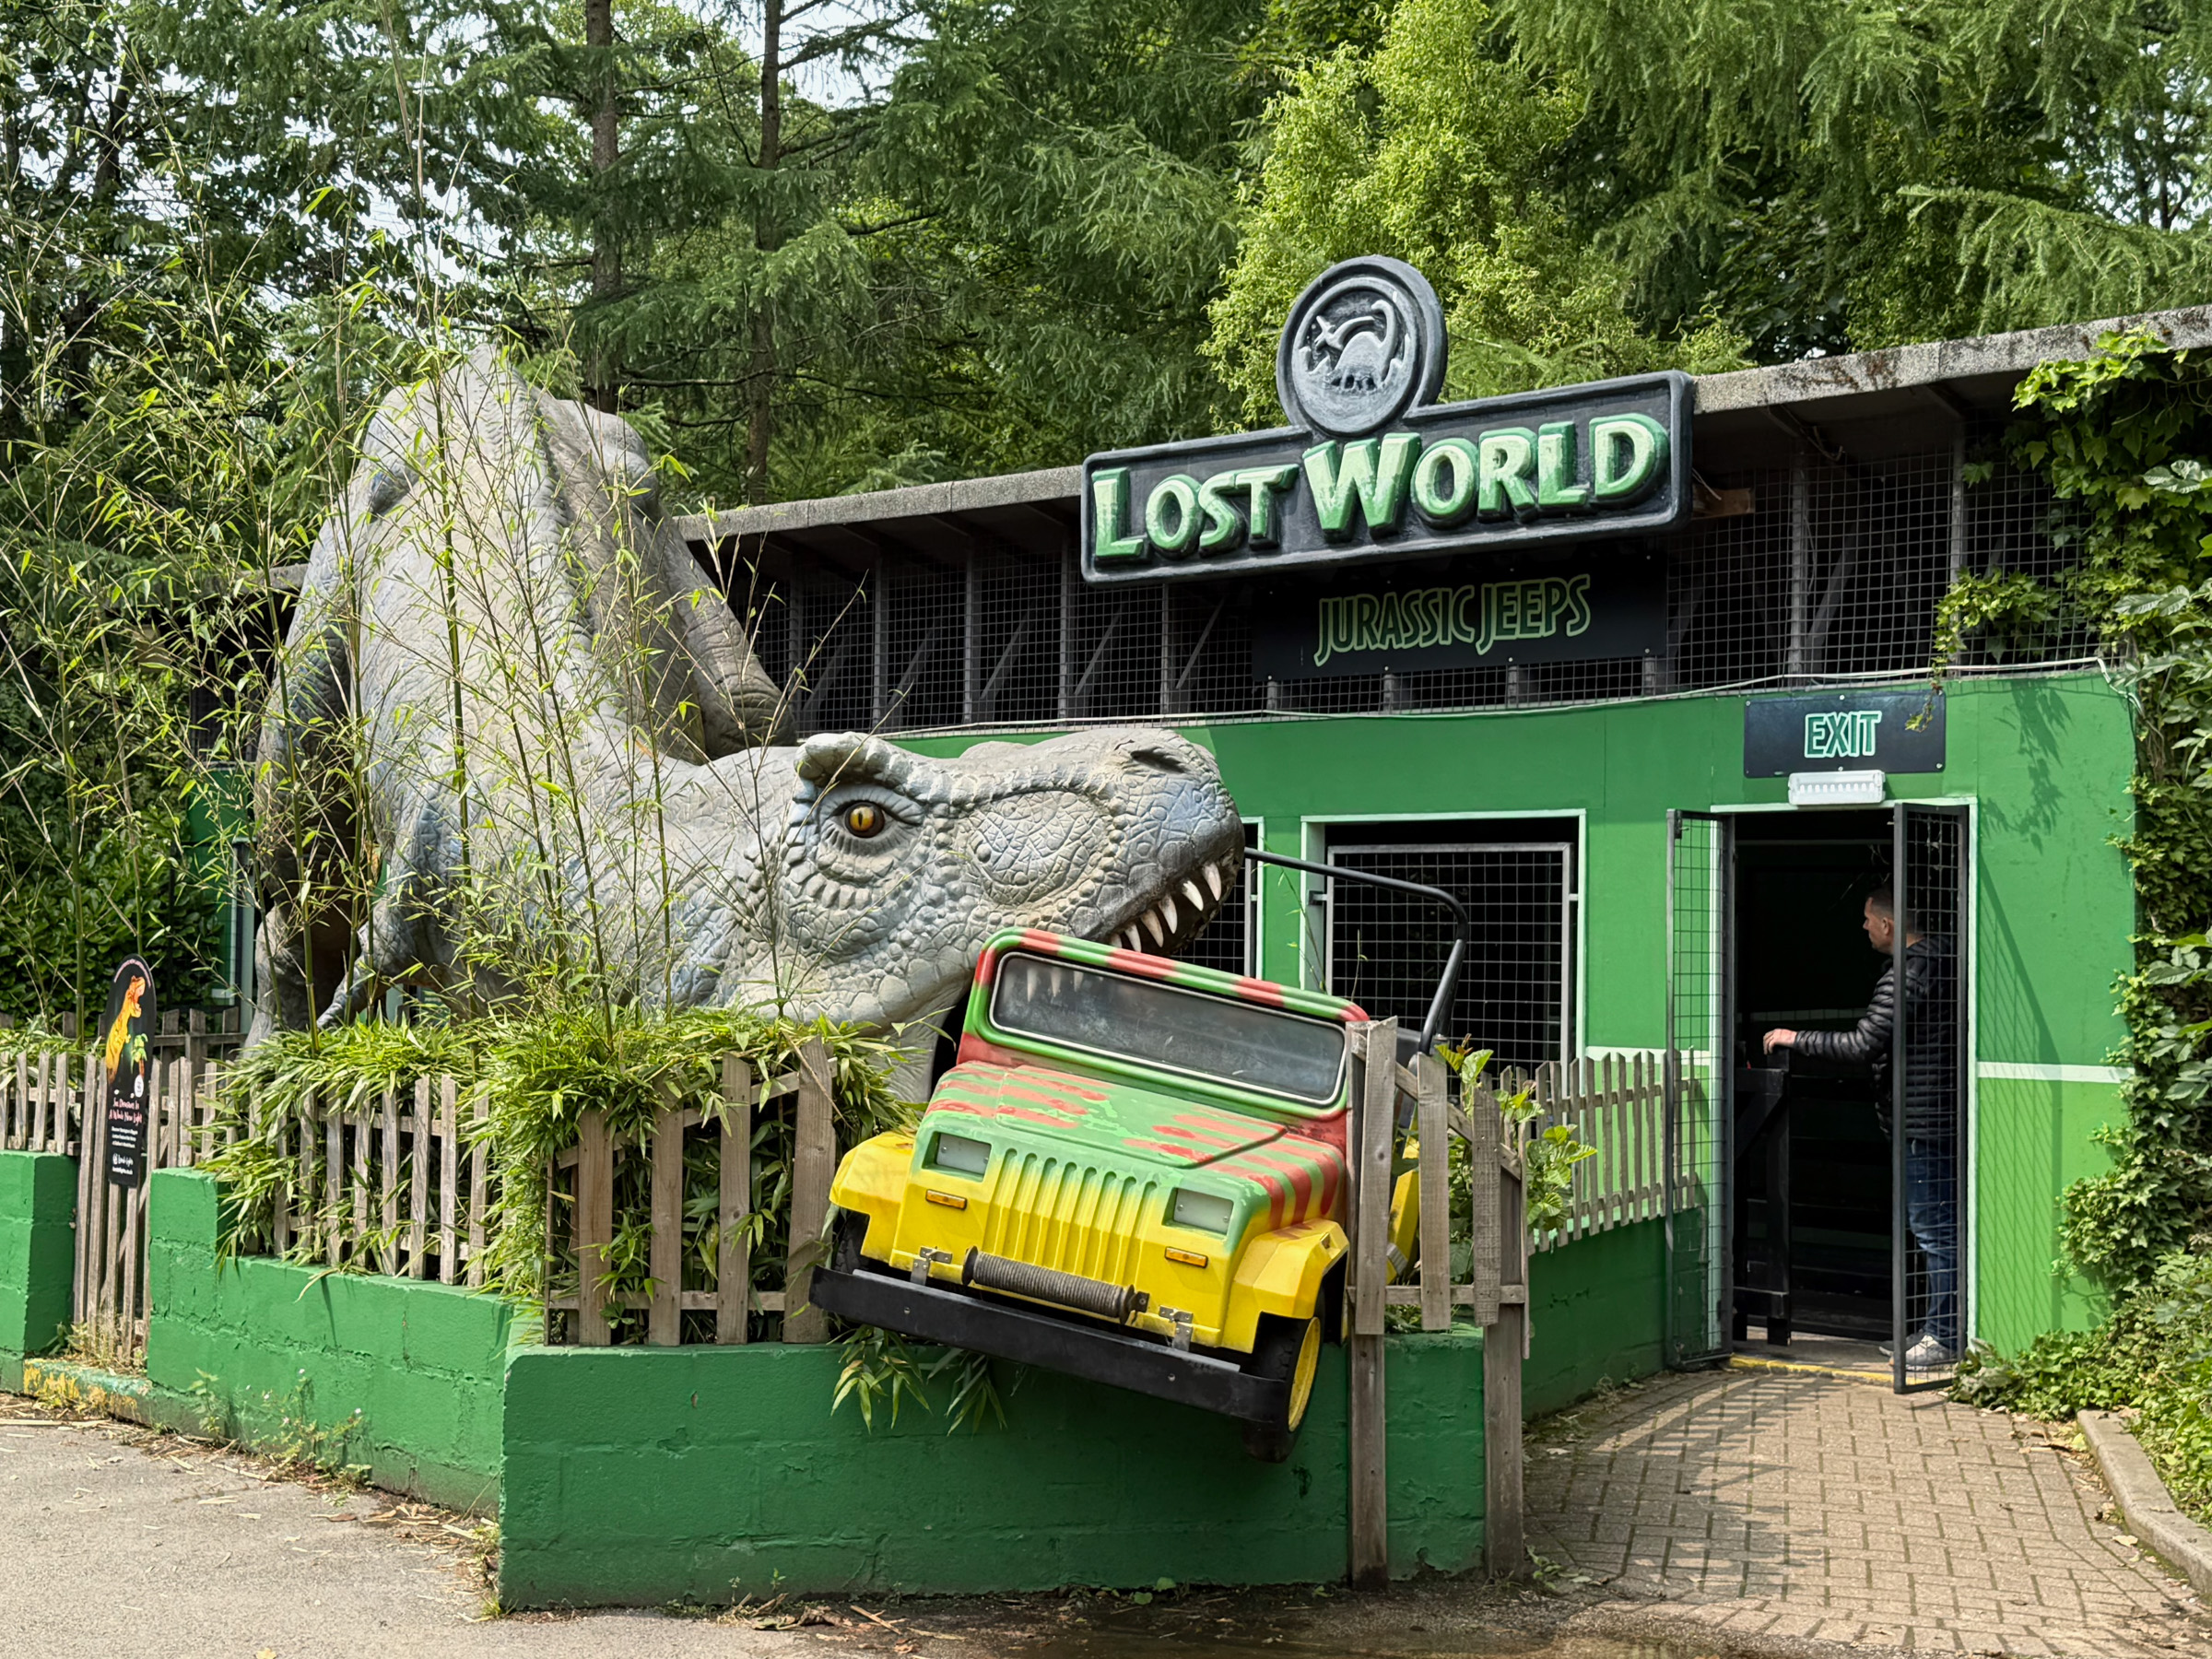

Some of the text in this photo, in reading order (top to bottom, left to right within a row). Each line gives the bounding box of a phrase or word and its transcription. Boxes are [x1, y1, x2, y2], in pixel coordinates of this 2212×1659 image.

[1091, 413, 1669, 559] LOST WORLD
[1314, 573, 1591, 666] JURASSIC JEEPS
[1804, 710, 1882, 758] EXIT
